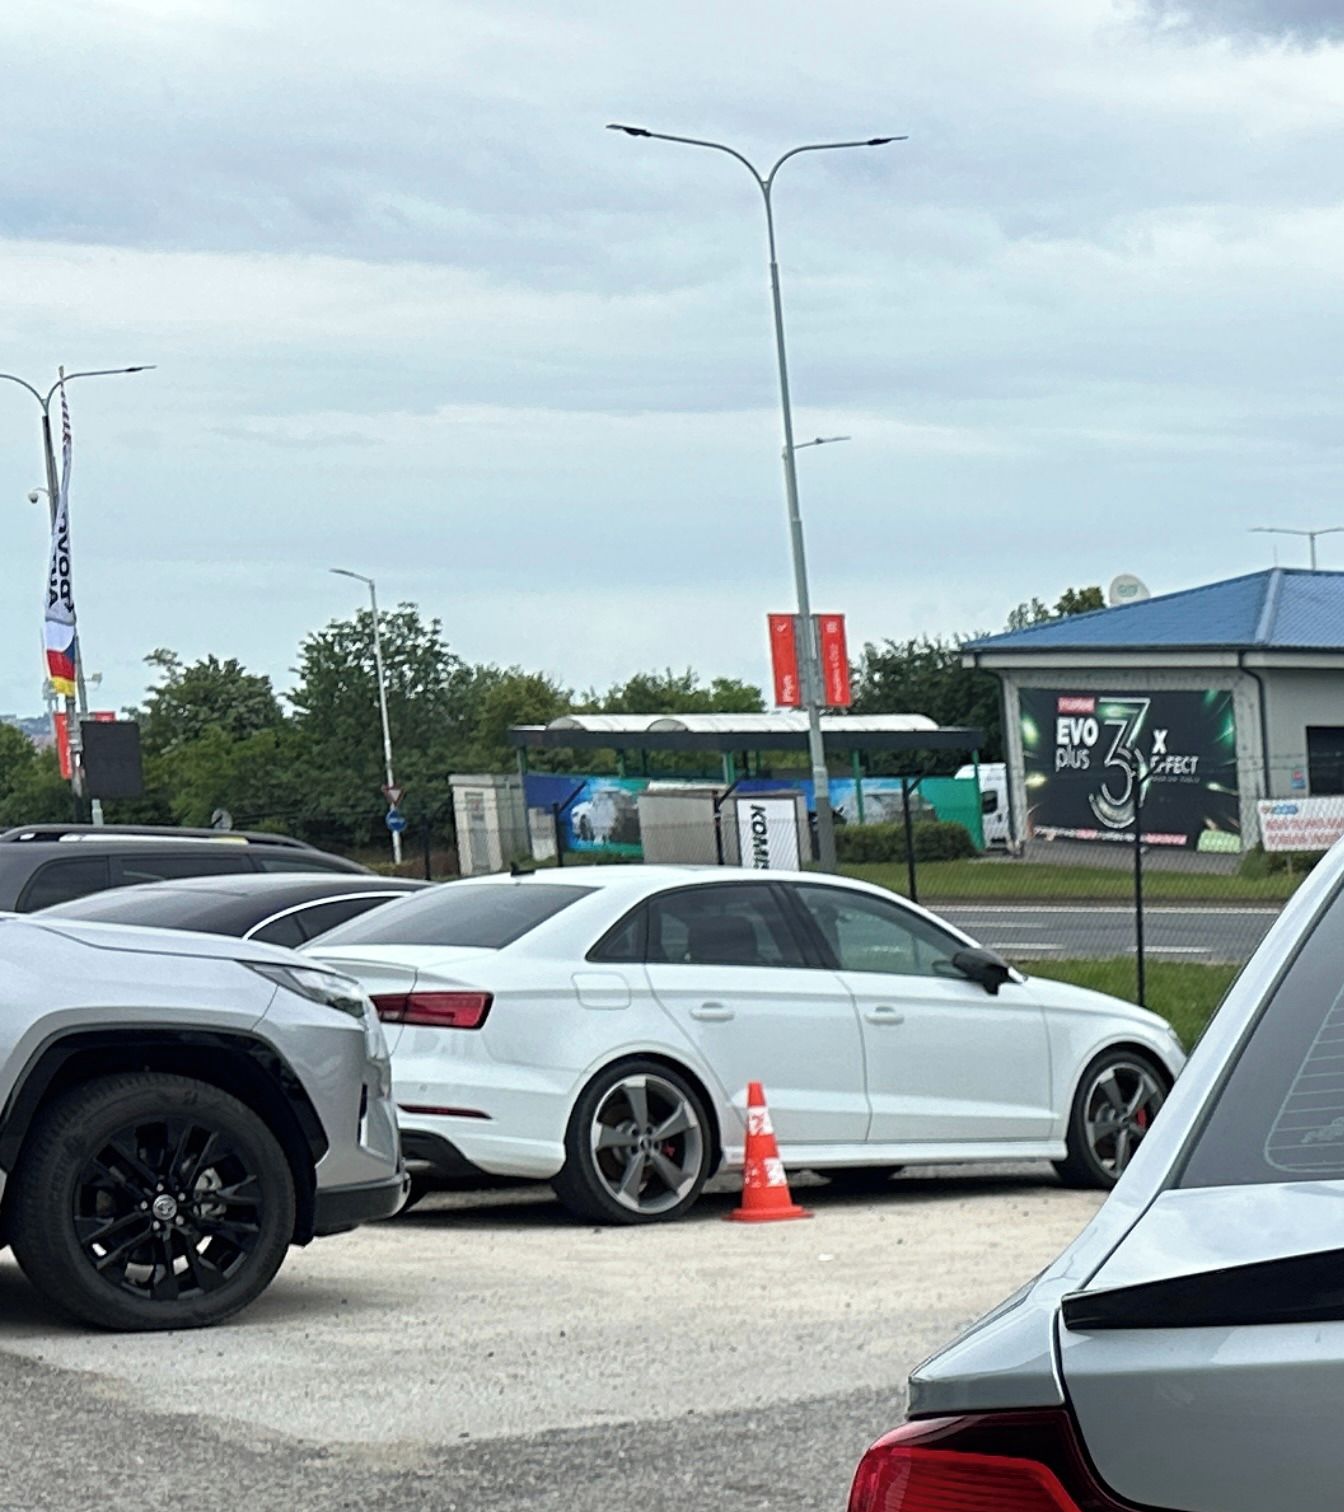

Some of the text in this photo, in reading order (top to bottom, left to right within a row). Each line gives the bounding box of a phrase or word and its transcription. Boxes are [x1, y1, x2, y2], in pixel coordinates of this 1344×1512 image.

[1056, 717, 1099, 747] EVO
[1152, 729, 1168, 754] X
[1056, 745, 1090, 772] plus
